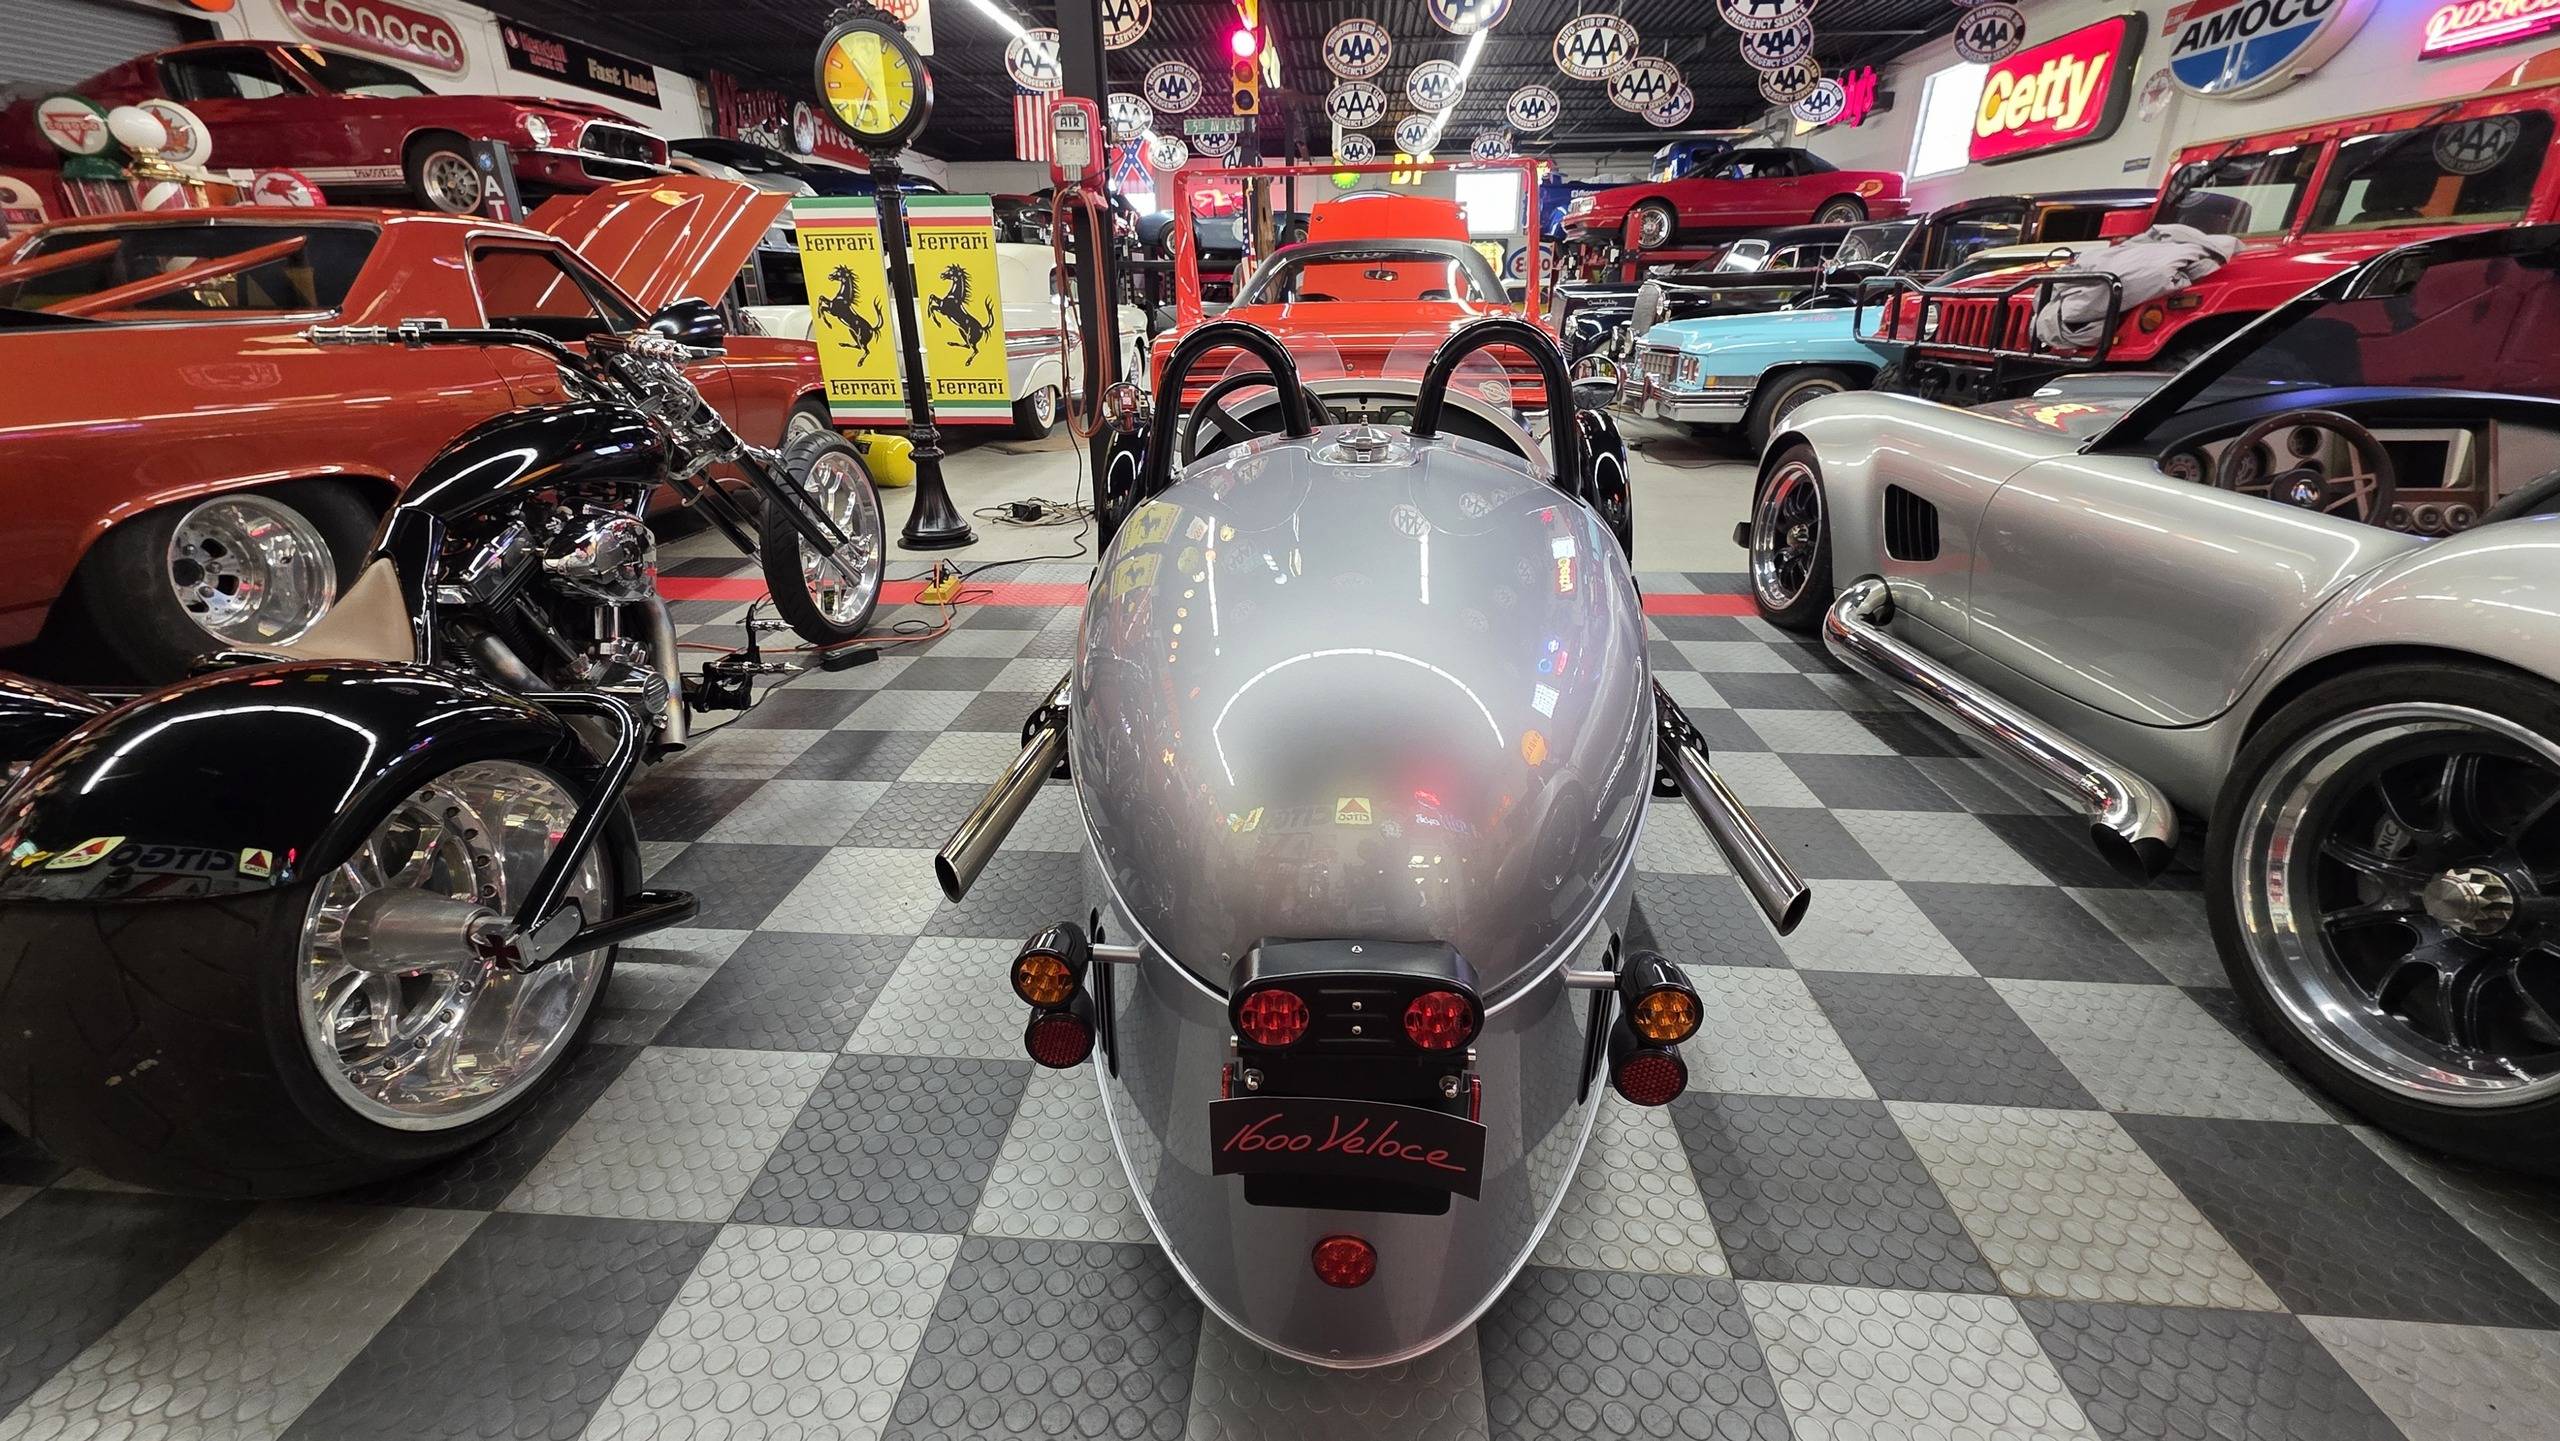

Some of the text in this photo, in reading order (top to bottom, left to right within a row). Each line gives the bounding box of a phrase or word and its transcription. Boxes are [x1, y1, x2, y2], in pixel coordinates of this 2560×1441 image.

[1725, 6, 1773, 30] EMERGENCY
[1773, 4, 1808, 28] SERVICE
[2171, 0, 2333, 57] AMOCO
[1114, 21, 1144, 46] SERVICE
[1374, 30, 1388, 47] CLUB
[1559, 26, 1576, 46] AUTO
[1576, 18, 1596, 30] CLUB
[1596, 18, 1606, 28] OF
[1757, 28, 1796, 55] AAA
[1969, 19, 2008, 49] AAA
[1339, 34, 1375, 64] AAA
[1568, 28, 1623, 66] AAA
[1744, 43, 1781, 68] EMERGENCY
[1781, 43, 1808, 67] SERVICE
[1993, 38, 2019, 60] SERVICE
[1327, 53, 1364, 76] EMERGENCY
[1364, 51, 1387, 74] SERVICE
[1561, 57, 1629, 78] EMERGENCY SERVICE
[588, 58, 656, 97] Fast Lube
[1158, 74, 1188, 100] AAA
[1421, 74, 1451, 99] AAA
[1619, 69, 1666, 100] AAA
[1774, 67, 1806, 91] AAA
[1148, 89, 1179, 110] EMERGENCY
[1336, 91, 1376, 118] AAA
[1520, 97, 1547, 118] AAA
[1803, 90, 1832, 112] AAA
[1975, 52, 2113, 138] Getty
[45, 121, 99, 131] CONOCO
[1060, 117, 1080, 128] AIR
[1225, 118, 1245, 132] EAST
[1344, 143, 1365, 159] AAA
[1481, 141, 1502, 158] AAA
[803, 232, 875, 252] Ferrari
[917, 231, 989, 250] Ferrari
[830, 379, 897, 396] Ferrari
[936, 378, 1004, 395] Ferrari
[1223, 1113, 1467, 1172] 1600 Veloce
